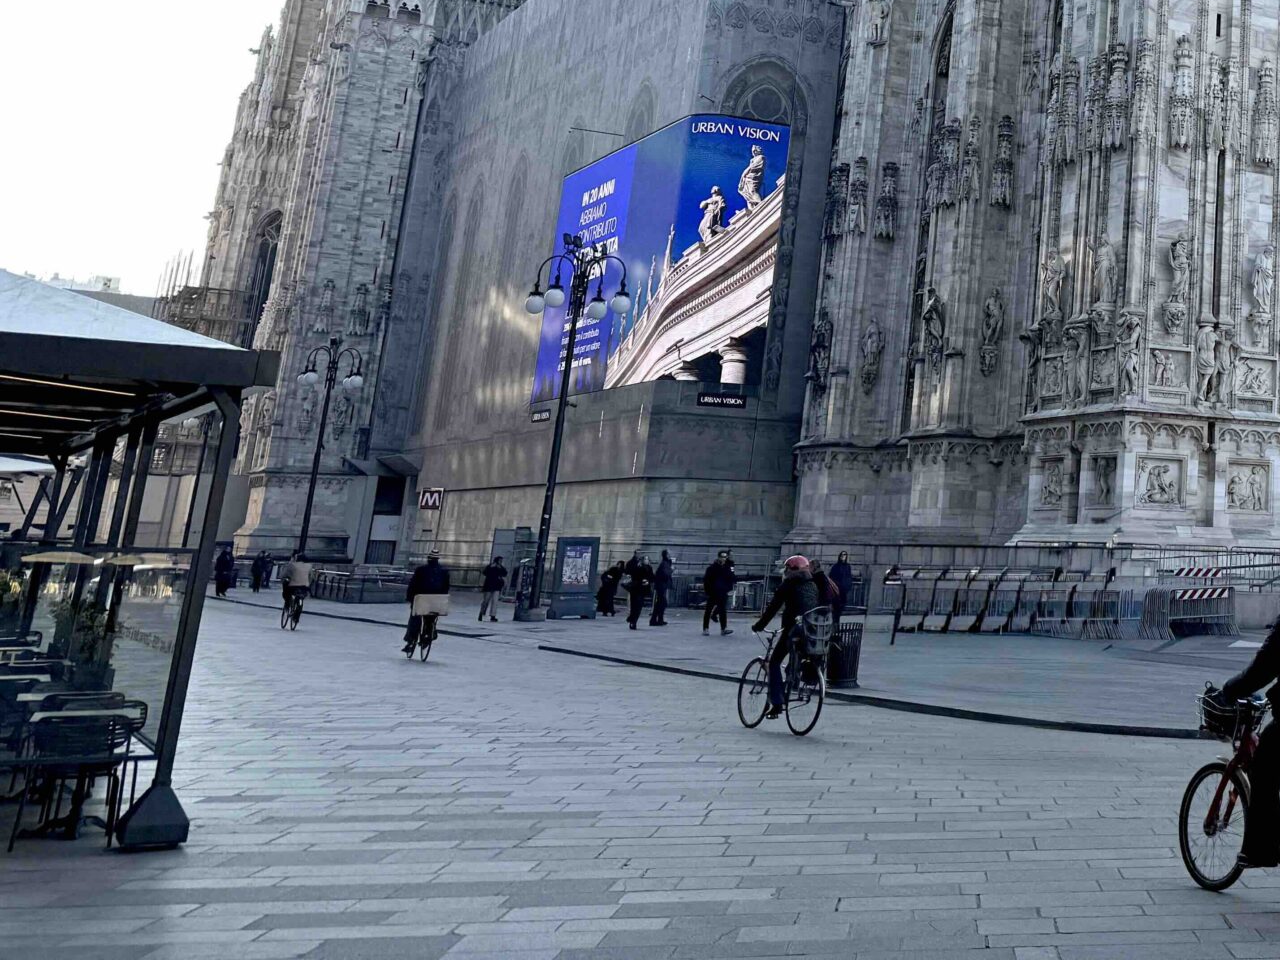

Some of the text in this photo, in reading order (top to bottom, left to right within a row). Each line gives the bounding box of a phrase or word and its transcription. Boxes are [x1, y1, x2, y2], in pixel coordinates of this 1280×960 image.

[692, 122, 780, 142] URBAN VISION
[582, 178, 616, 207] IN 20 ANNI
[579, 202, 607, 227] ABBIAMO
[421, 492, 440, 506] M
